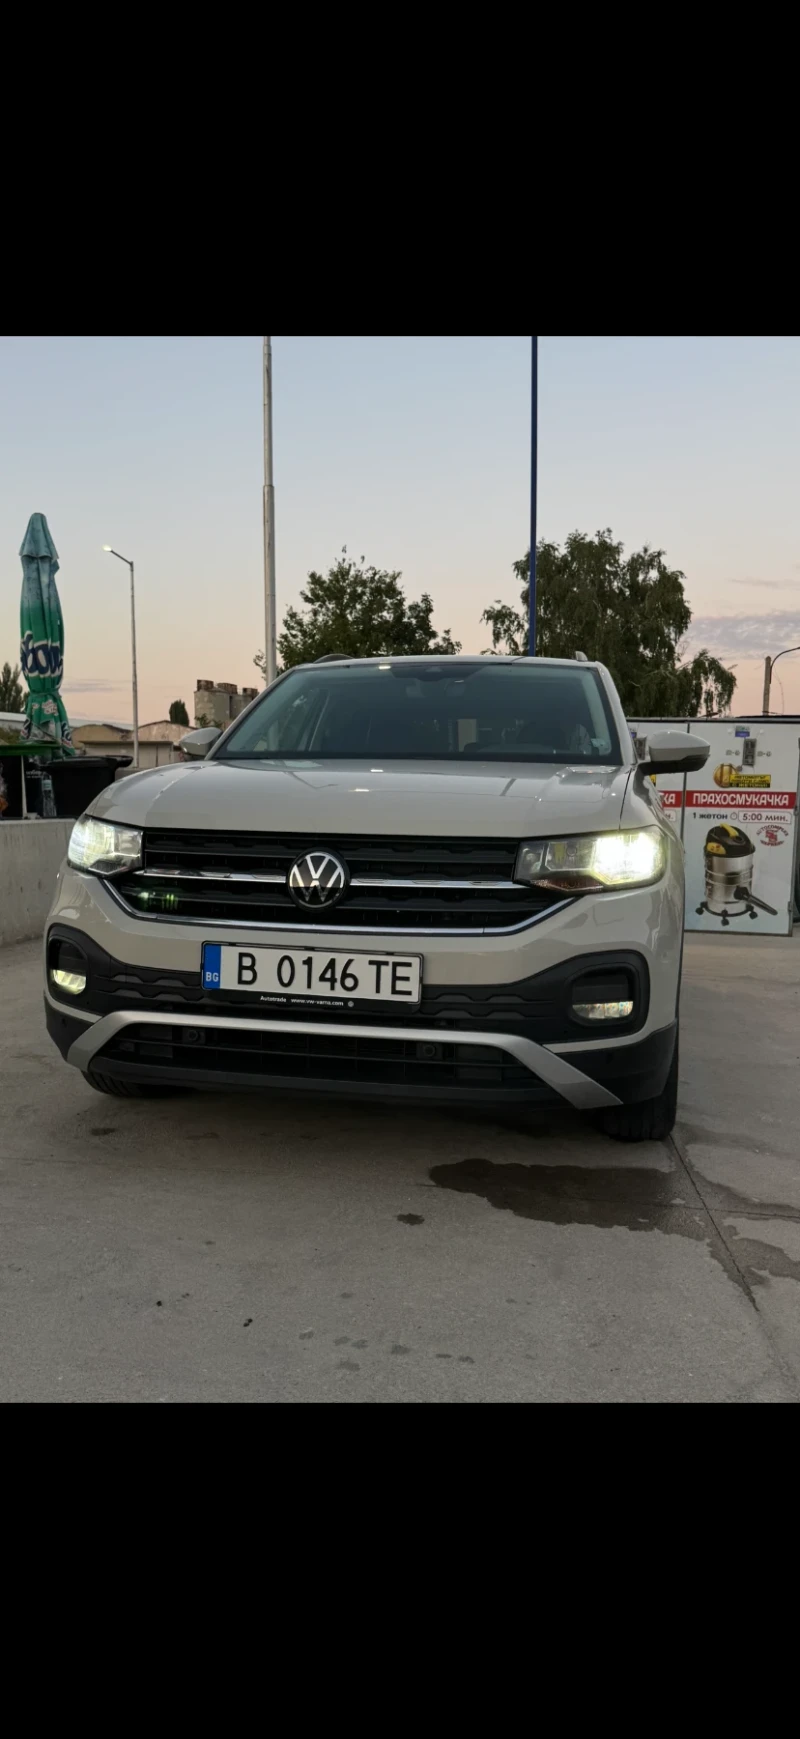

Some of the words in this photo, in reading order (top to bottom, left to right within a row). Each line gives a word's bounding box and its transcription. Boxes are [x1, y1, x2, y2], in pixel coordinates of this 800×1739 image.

[693, 793, 789, 806] ПРАХОСМУКАЧКА
[742, 812, 762, 821] 5:00
[765, 814, 788, 822] мин.
[205, 971, 219, 982] BG
[237, 952, 258, 985] B
[277, 955, 359, 992] 0146
[368, 960, 413, 996] TE
[260, 995, 287, 1003] Autotrade
[291, 998, 344, 1006] www.vw-varna.com
